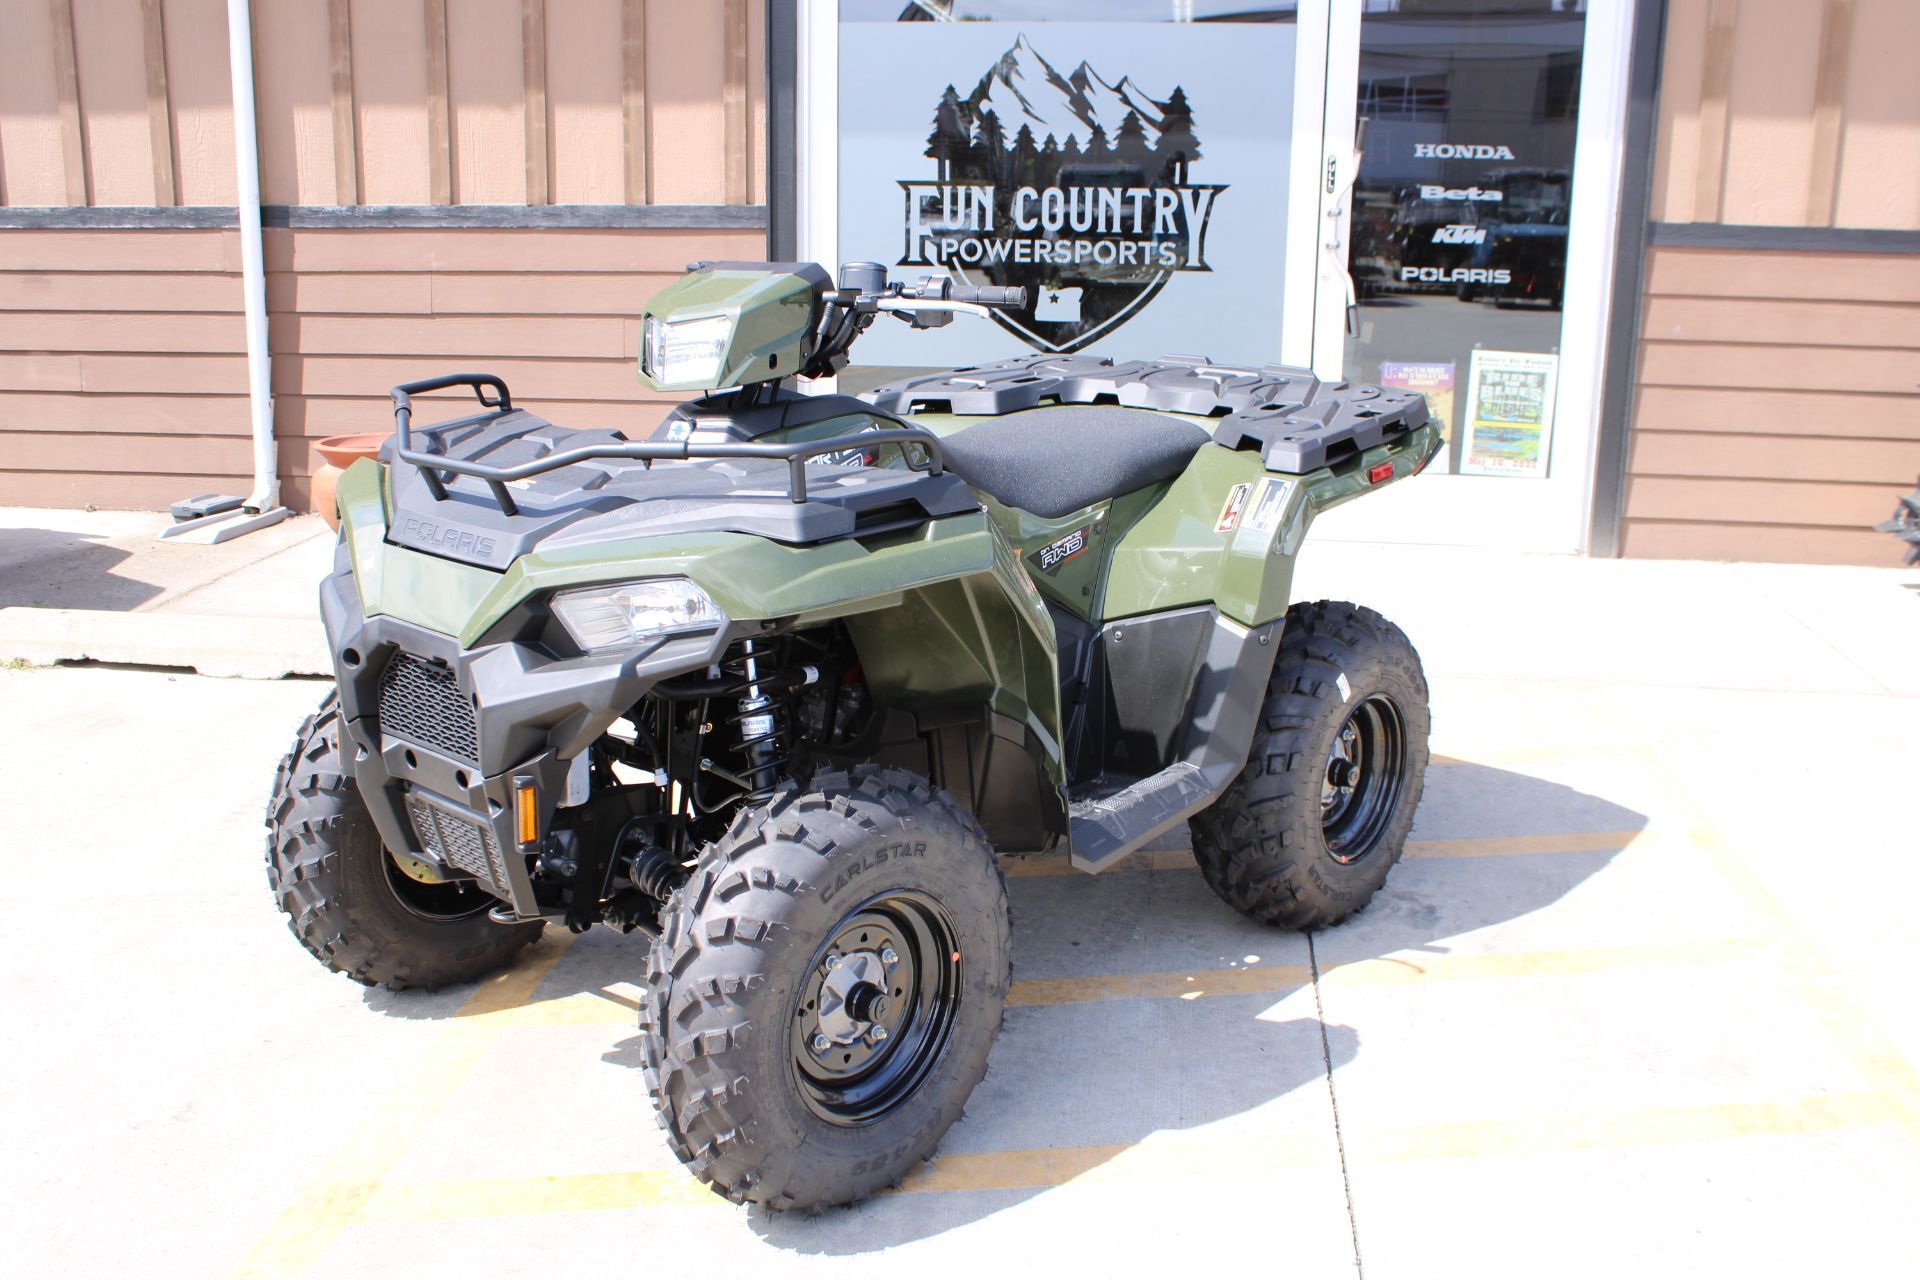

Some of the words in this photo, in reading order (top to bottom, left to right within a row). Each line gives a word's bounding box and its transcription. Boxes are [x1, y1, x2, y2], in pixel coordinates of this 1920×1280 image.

[1414, 143, 1515, 160] HONDA
[1420, 185, 1503, 201] Beta
[906, 185, 995, 261] FUN
[1015, 185, 1215, 267] COUNTRY
[1431, 224, 1488, 244] KTM
[940, 238, 1177, 266] POWERSPORTS
[1401, 266, 1512, 284] POLARIS
[403, 518, 497, 558] POLARIS
[1041, 536, 1083, 569] AWD
[819, 842, 927, 904] CARLSTAR
